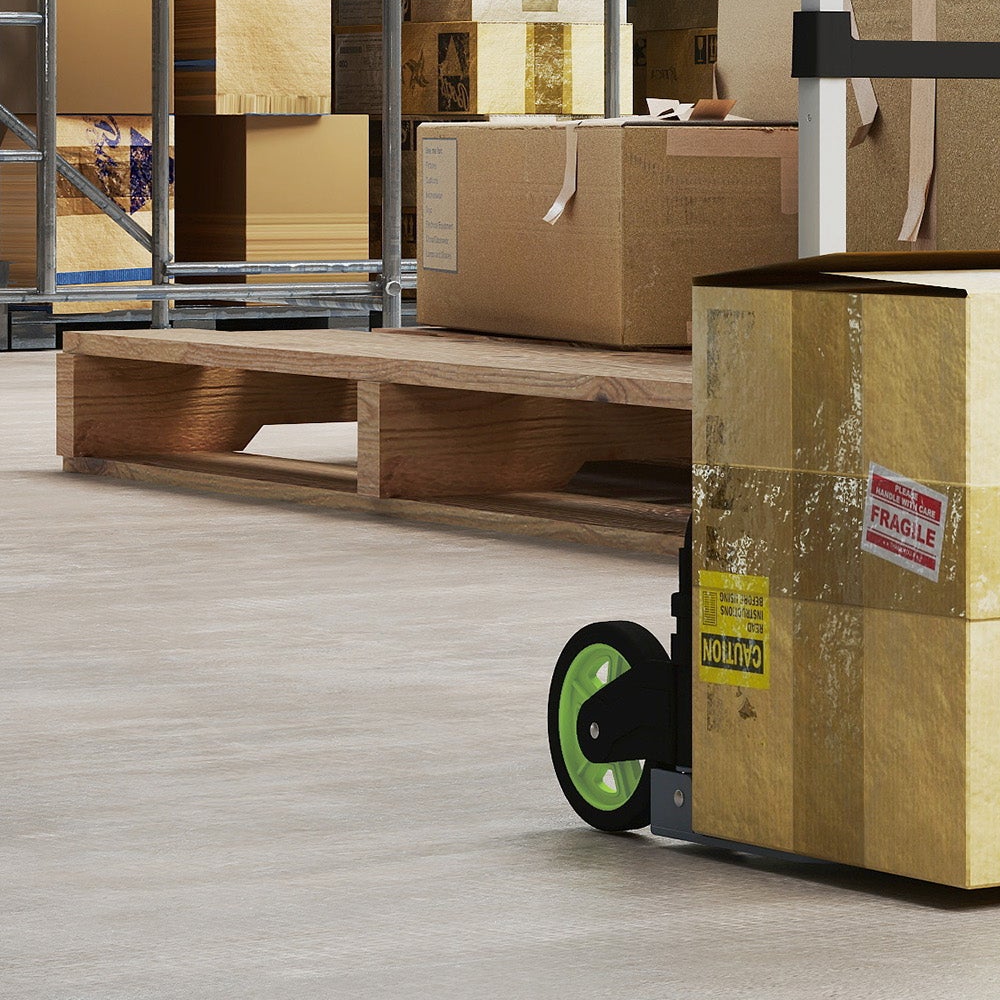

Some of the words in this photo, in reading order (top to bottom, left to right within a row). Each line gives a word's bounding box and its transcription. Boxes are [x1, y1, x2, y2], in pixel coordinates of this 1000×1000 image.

[875, 487, 900, 504] HANDLE
[901, 497, 917, 511] WITH
[918, 504, 936, 519] CARE
[894, 484, 918, 500] PLEASE
[870, 504, 936, 548] FRAGILE
[720, 605, 764, 620] INSTRUCTIONS
[747, 623, 764, 634] READ
[702, 638, 762, 669] CAUTION
